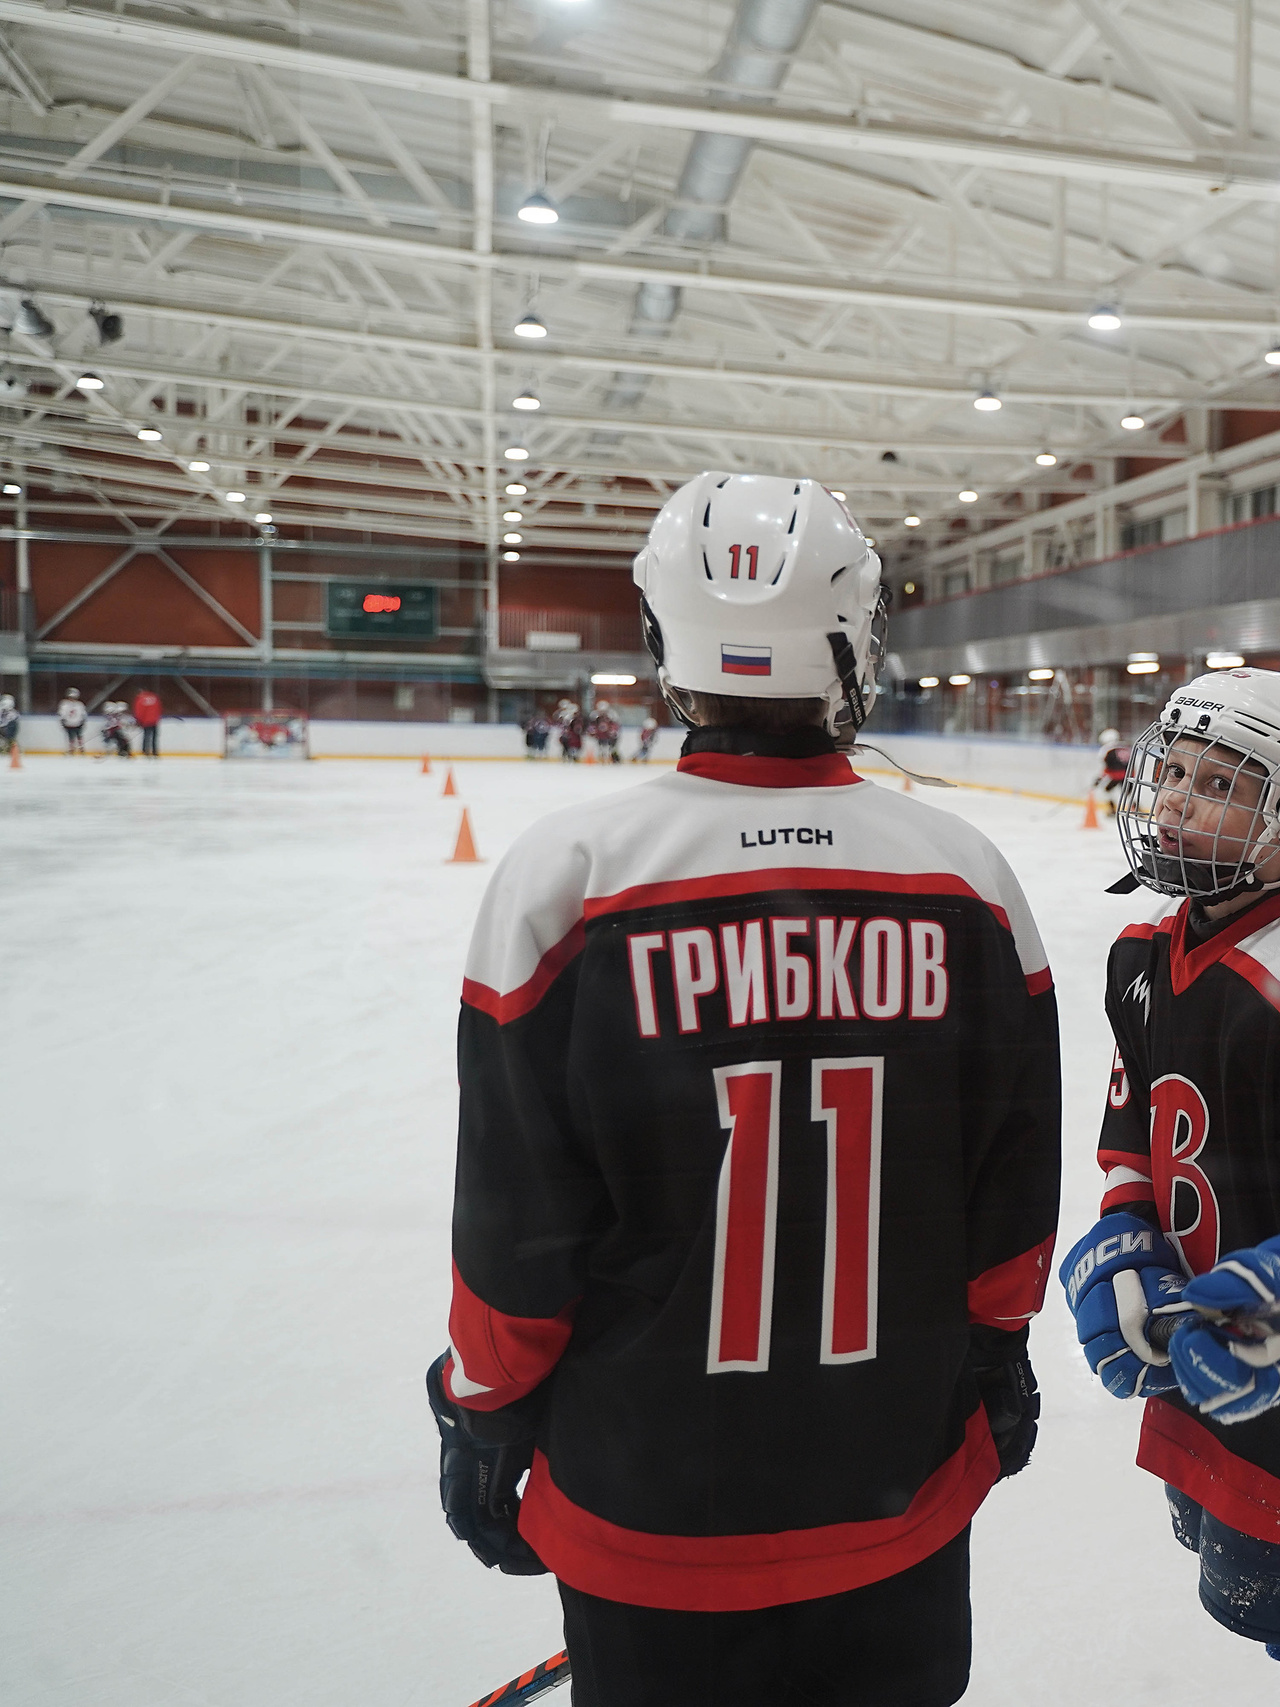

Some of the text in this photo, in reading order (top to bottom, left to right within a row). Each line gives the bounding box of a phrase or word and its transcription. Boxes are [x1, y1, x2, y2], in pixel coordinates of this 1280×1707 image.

[729, 544, 759, 580] 11
[1174, 696, 1225, 712] BAUER
[741, 828, 833, 848] LUTCH
[626, 916, 949, 1039] ГРИБКОВ
[706, 1056, 884, 1374] 11
[1066, 1231, 1154, 1307] ЭФСИ
